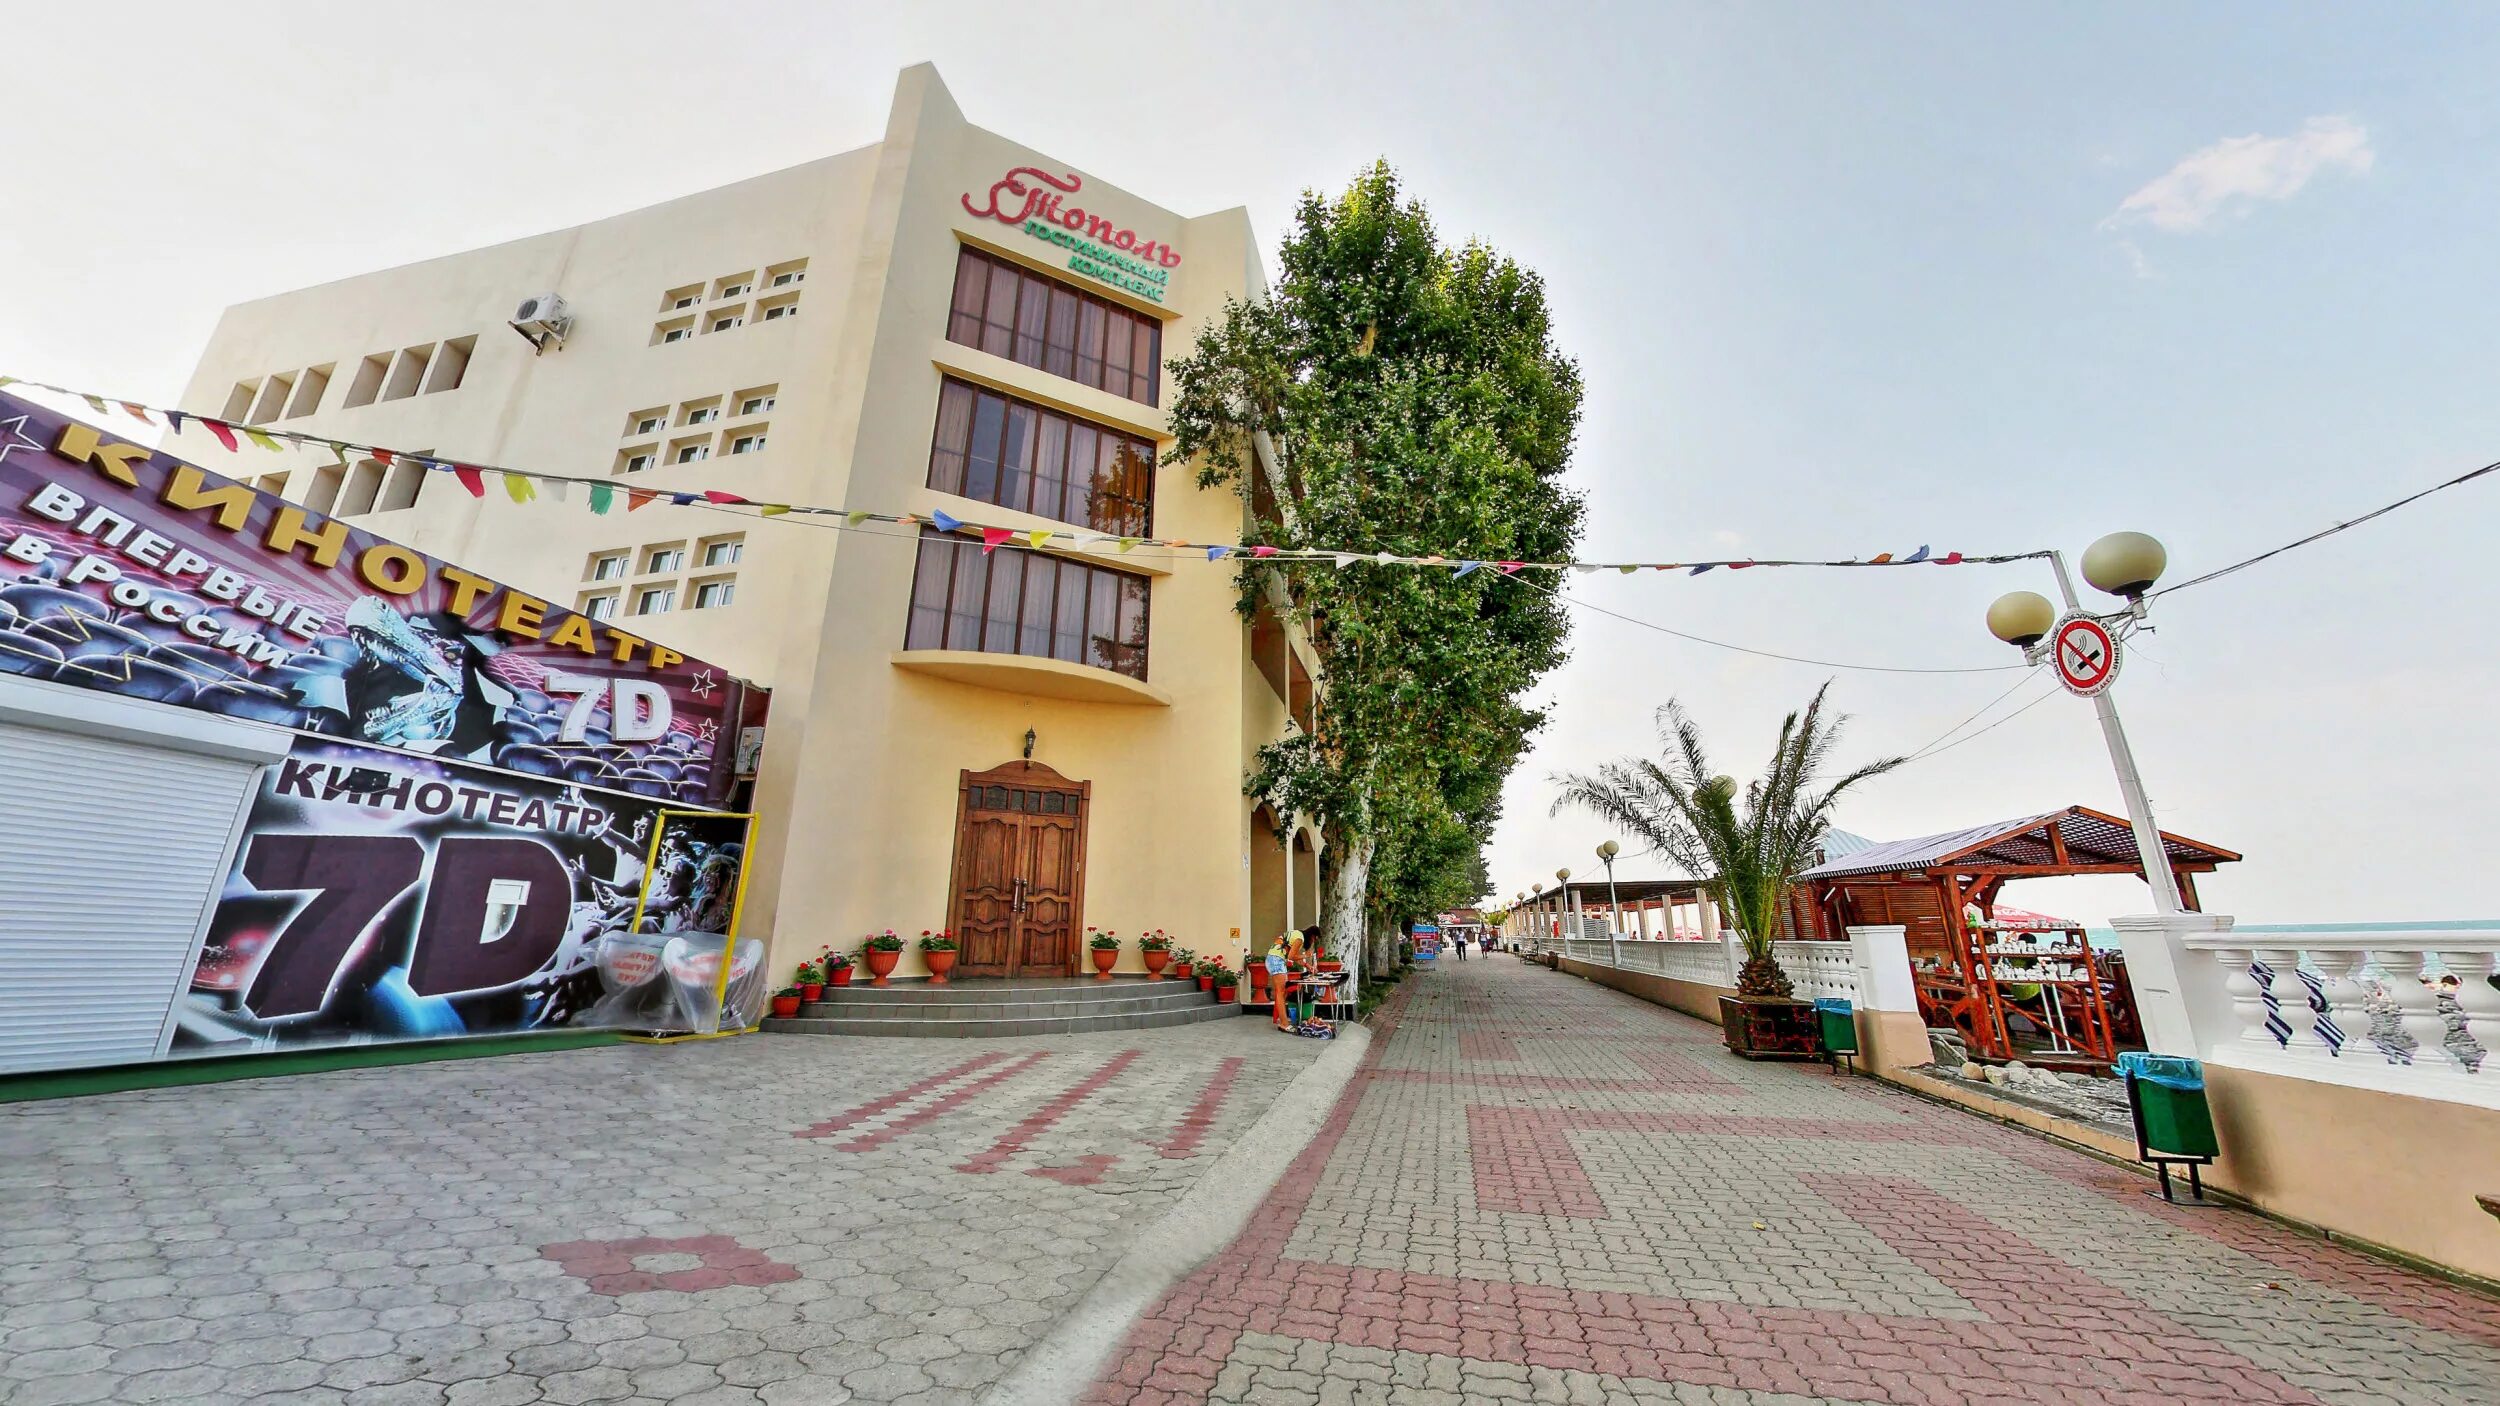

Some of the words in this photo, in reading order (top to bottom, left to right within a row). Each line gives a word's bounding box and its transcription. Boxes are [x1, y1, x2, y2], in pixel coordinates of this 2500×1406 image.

[1024, 219, 1169, 286] ГОСТИНИЧНЫЙ
[1068, 255, 1166, 303] КОМПЛЕКС
[4, 532, 53, 565] В
[25, 482, 328, 641] ВПЕРВЫЕ
[54, 422, 684, 669] КИНОТЕАТР
[2101, 622, 2111, 632] ОТ
[545, 674, 673, 743] 7D
[275, 758, 604, 836] КИНОТЕАТР
[241, 834, 574, 1021] 7D
